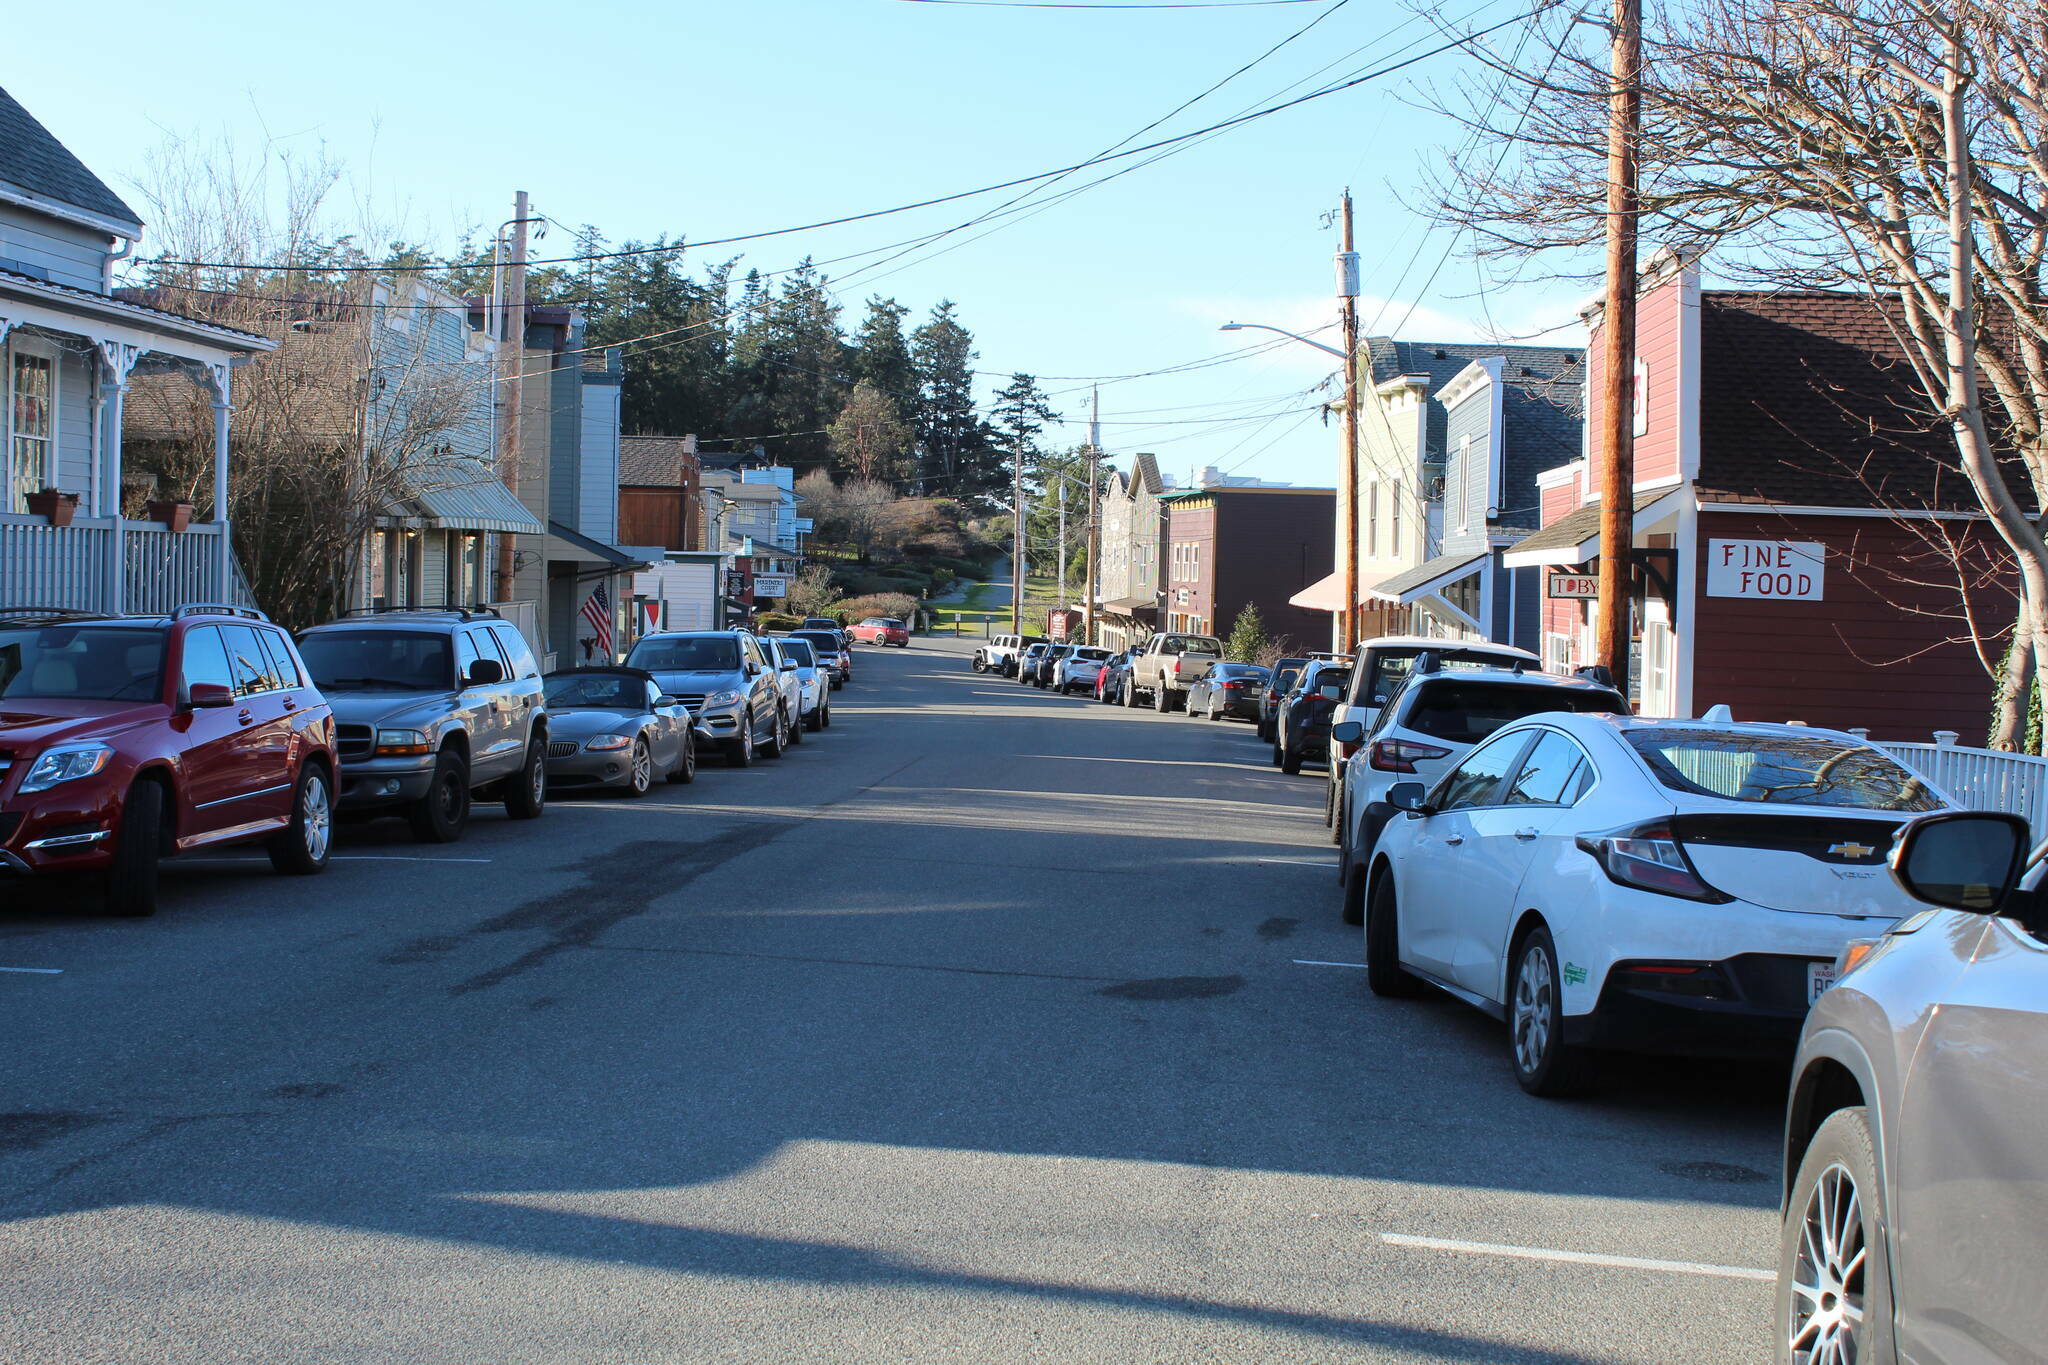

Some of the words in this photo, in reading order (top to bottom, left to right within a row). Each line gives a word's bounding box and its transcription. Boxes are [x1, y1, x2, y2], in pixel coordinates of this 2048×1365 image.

[1721, 544, 1793, 568] FINE
[1553, 578, 1600, 594] TOBY
[1739, 571, 1812, 596] FOOD
